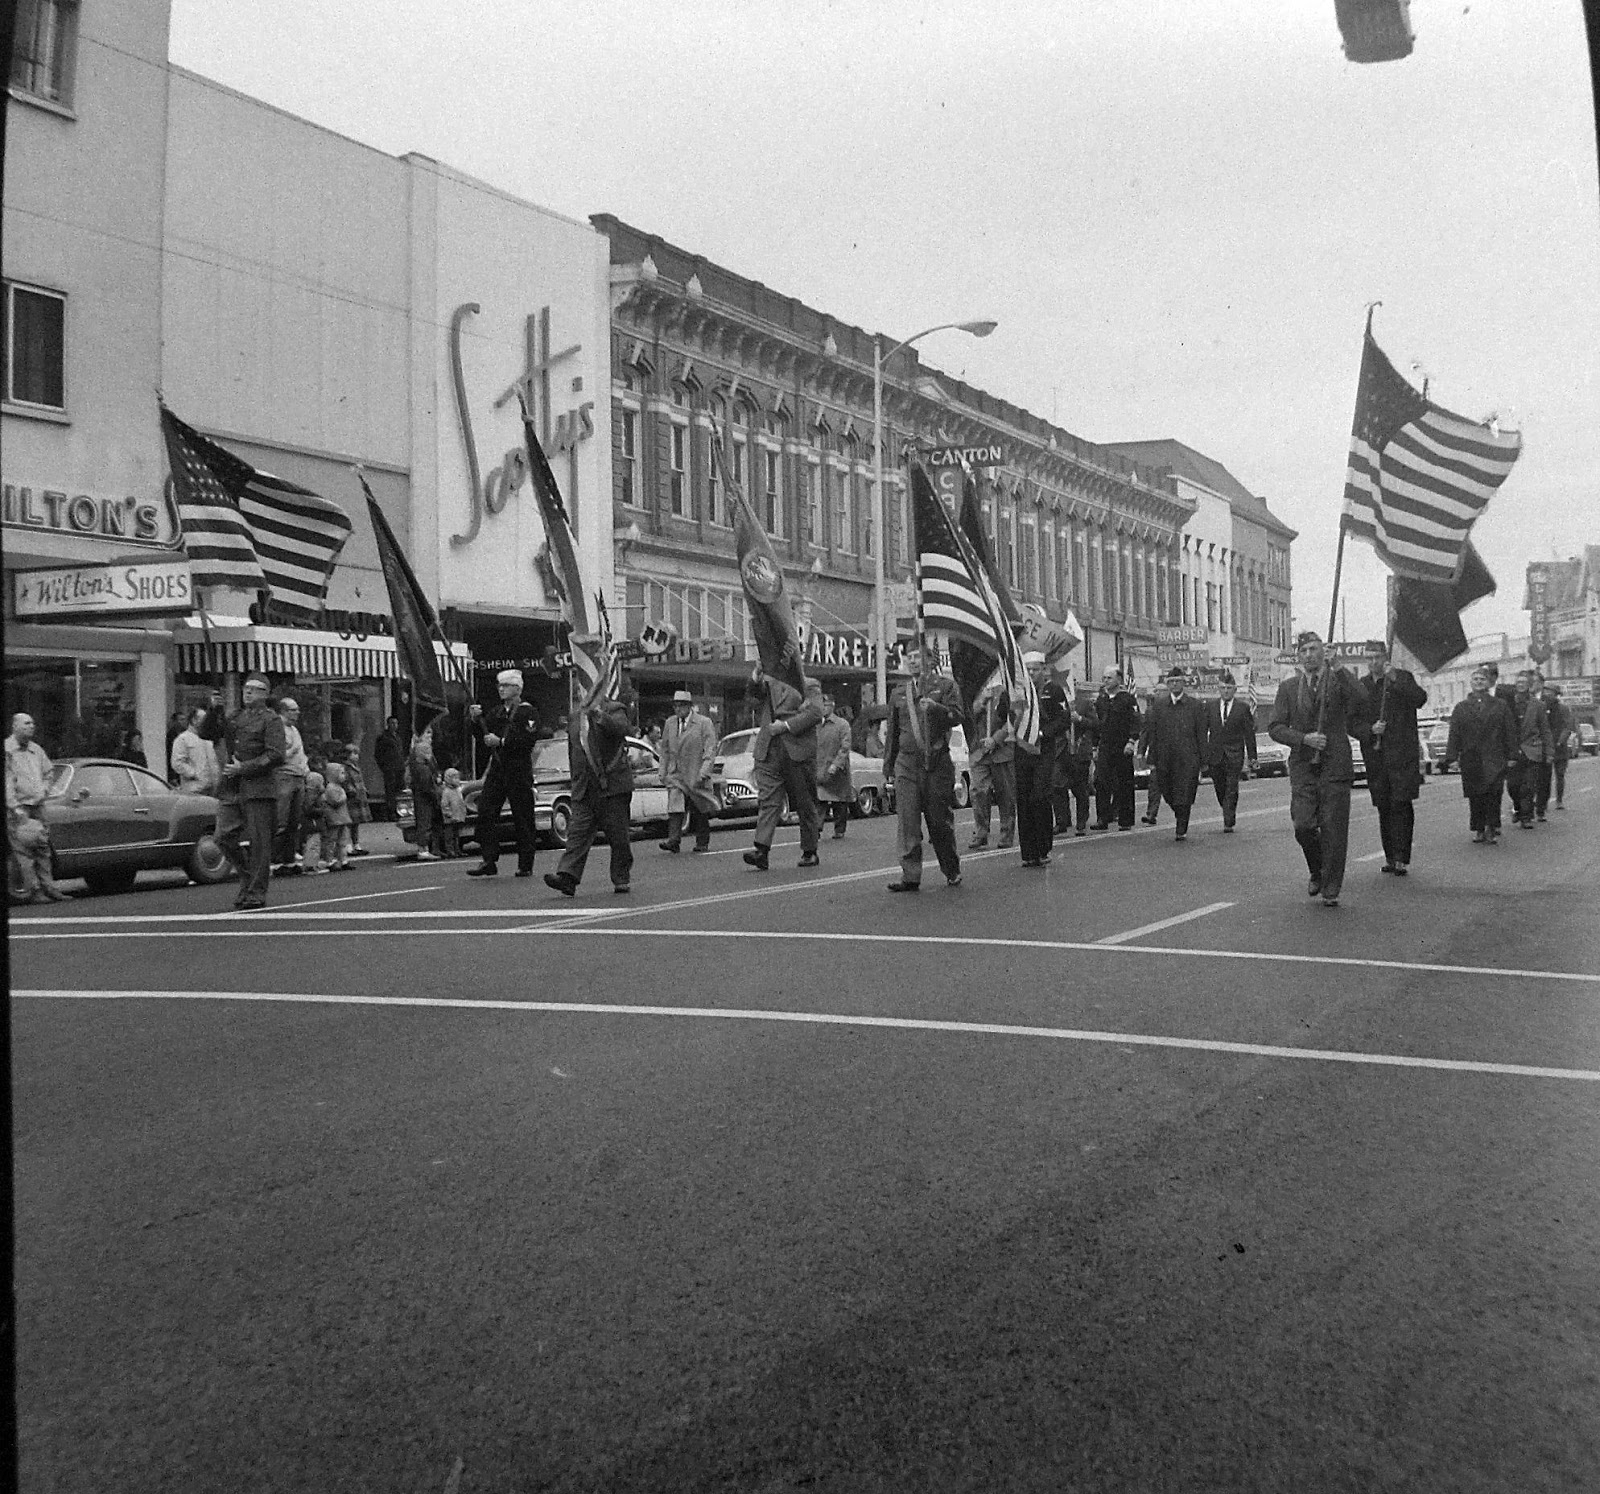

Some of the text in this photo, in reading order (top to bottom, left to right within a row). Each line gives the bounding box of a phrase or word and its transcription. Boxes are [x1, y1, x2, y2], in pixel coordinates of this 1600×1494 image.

[931, 445, 1002, 466] CANTON
[4, 484, 158, 539] ILTON'S
[37, 568, 188, 606] Wilton's SHOES
[1159, 629, 1204, 641] BARBER
